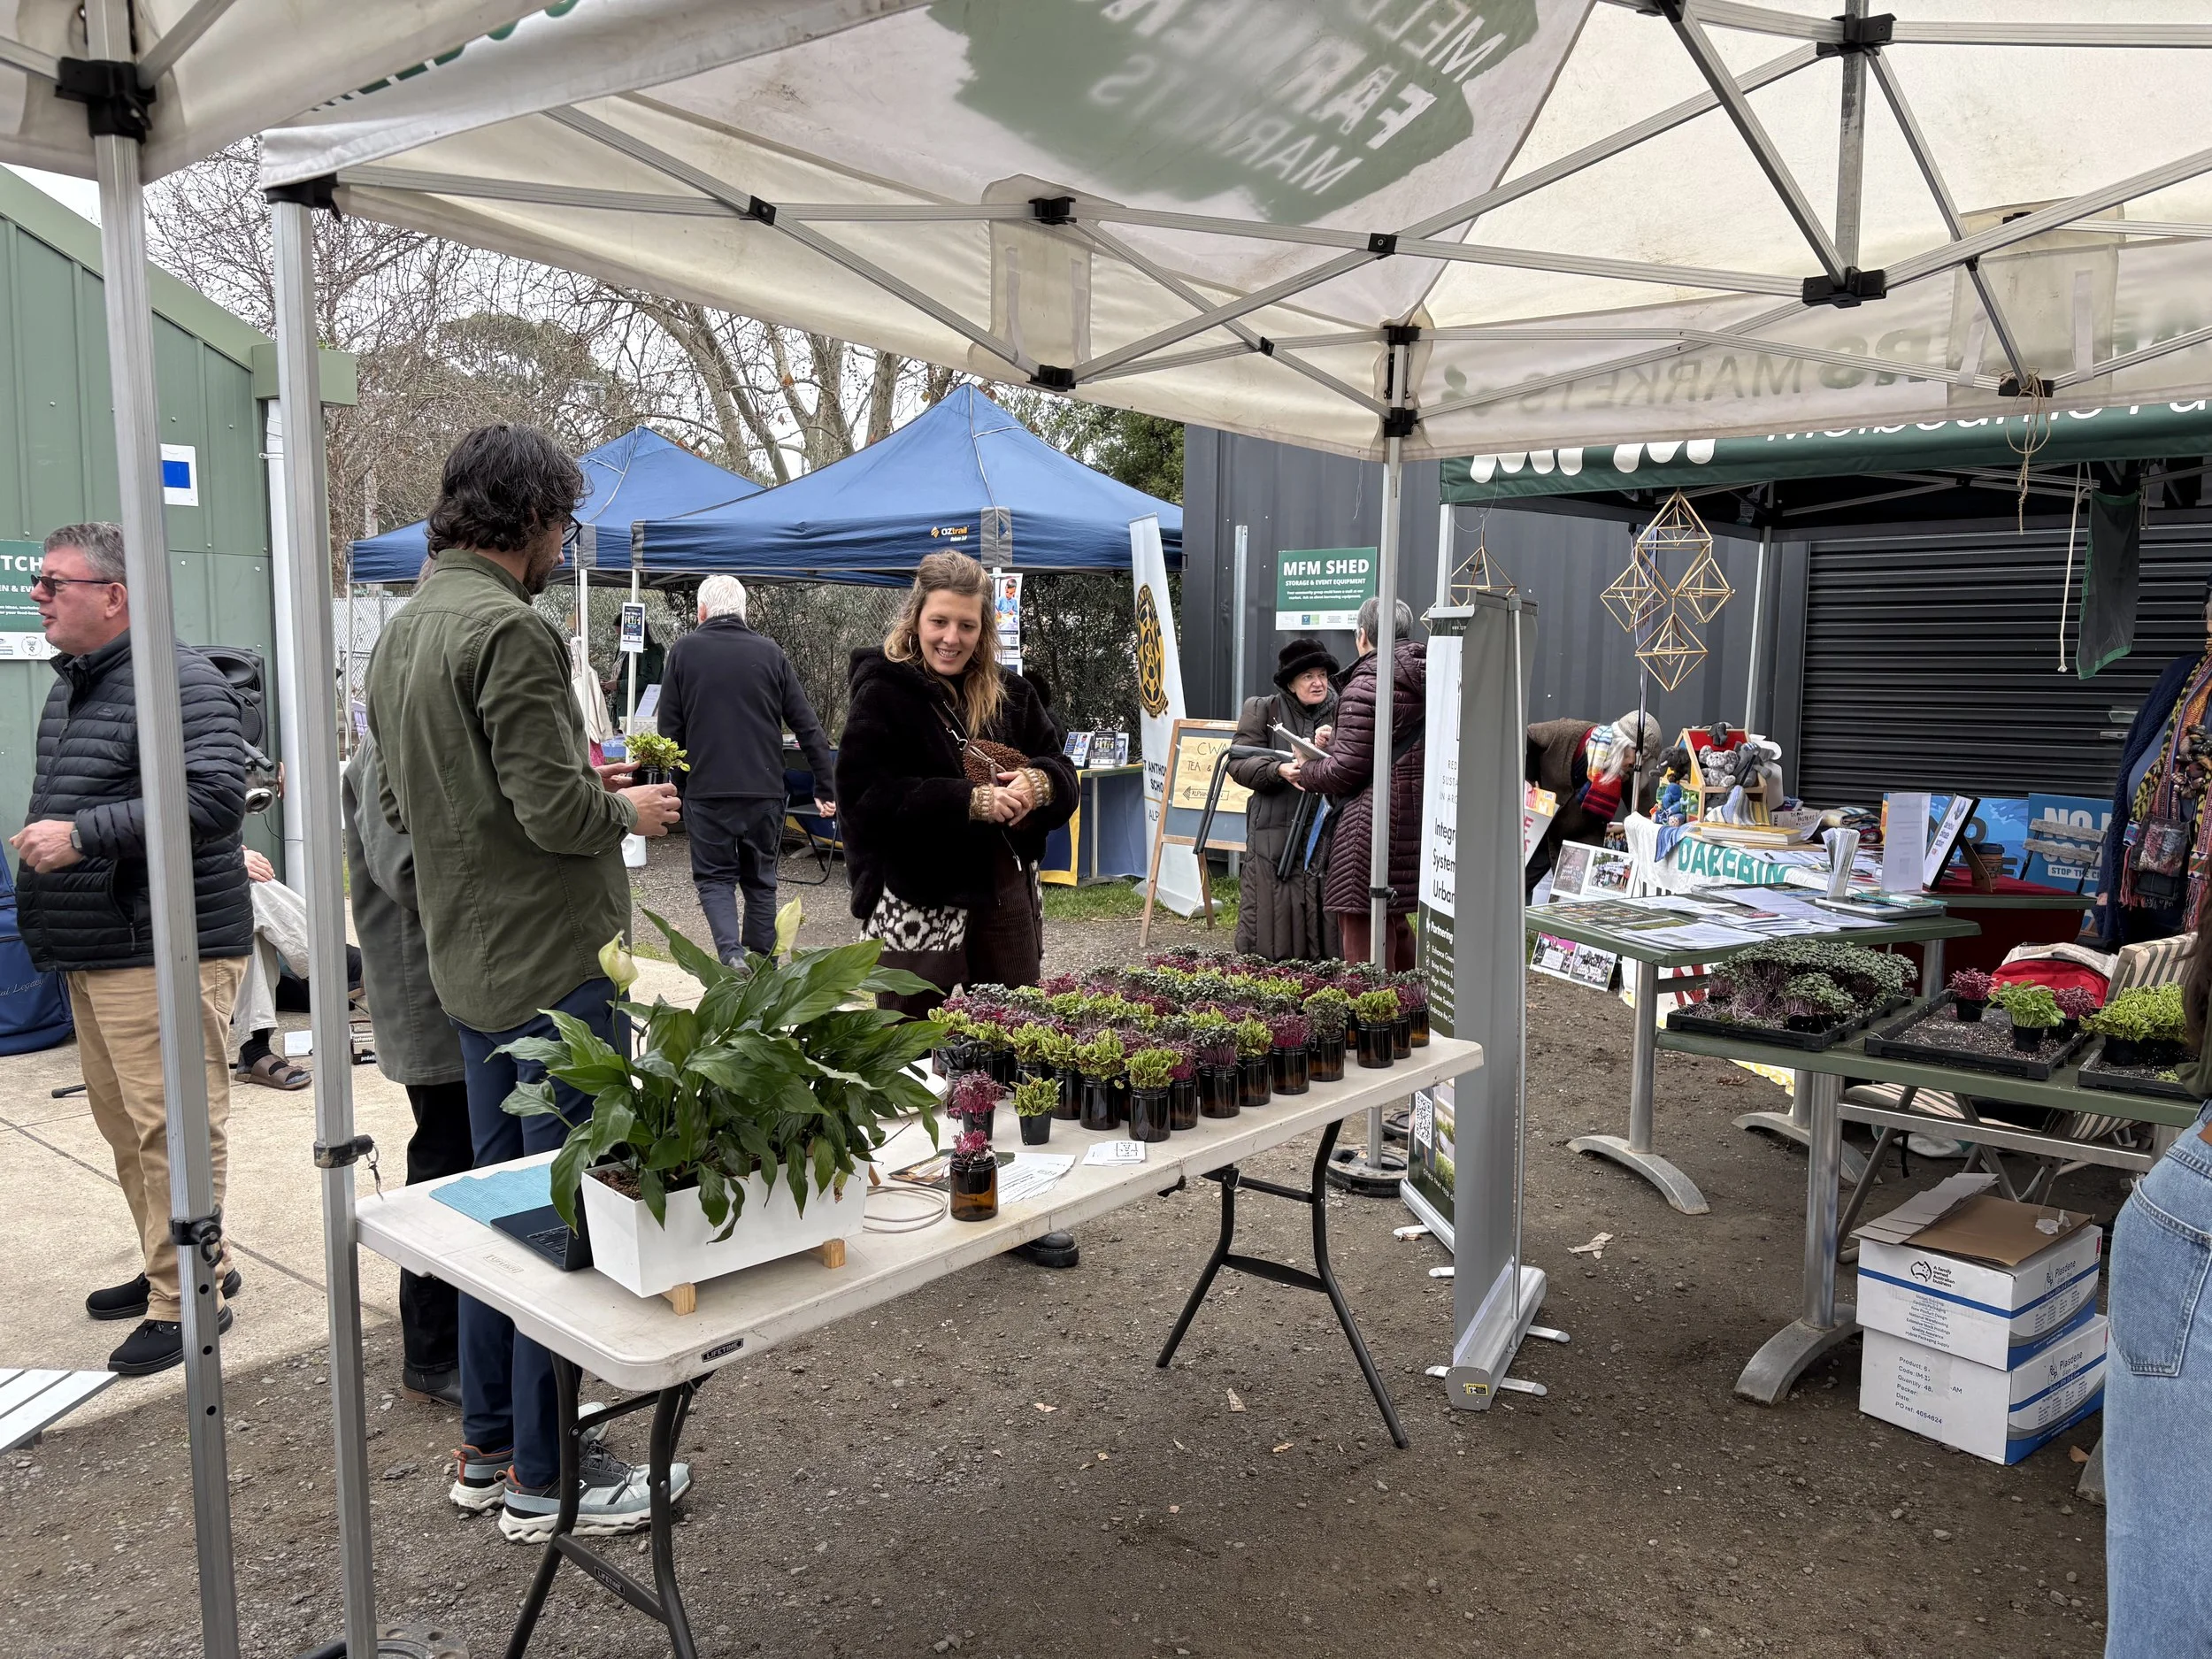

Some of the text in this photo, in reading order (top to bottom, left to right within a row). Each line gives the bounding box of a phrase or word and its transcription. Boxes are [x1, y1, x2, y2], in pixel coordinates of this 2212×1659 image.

[1283, 558, 1370, 576] MFM SHED
[1187, 761, 1202, 772] TEA
[2042, 806, 2093, 841] NO
[1678, 836, 1796, 885] DAREBIN
[2051, 867, 2071, 876] STOP
[1431, 921, 1454, 945] Partnering
[1432, 944, 1445, 958] Enhance
[1938, 1266, 1952, 1276] family
[2055, 1260, 2077, 1278] Plasdene
[1932, 1274, 1955, 1285] Australian
[1932, 1279, 1952, 1288] business
[1909, 1311, 1925, 1321] National
[1919, 1307, 1934, 1317] Product
[1911, 1325, 1944, 1340] Quality Assurance
[1917, 1333, 1937, 1345] Packaging
[1937, 1340, 1950, 1348] Supply
[706, 1340, 740, 1359] LIFETIME
[2059, 1350, 2083, 1371] Plasdene
[1897, 1374, 1924, 1389] Quantity:
[1897, 1383, 1918, 1396] Packer:
[1895, 1401, 1904, 1409] PO
